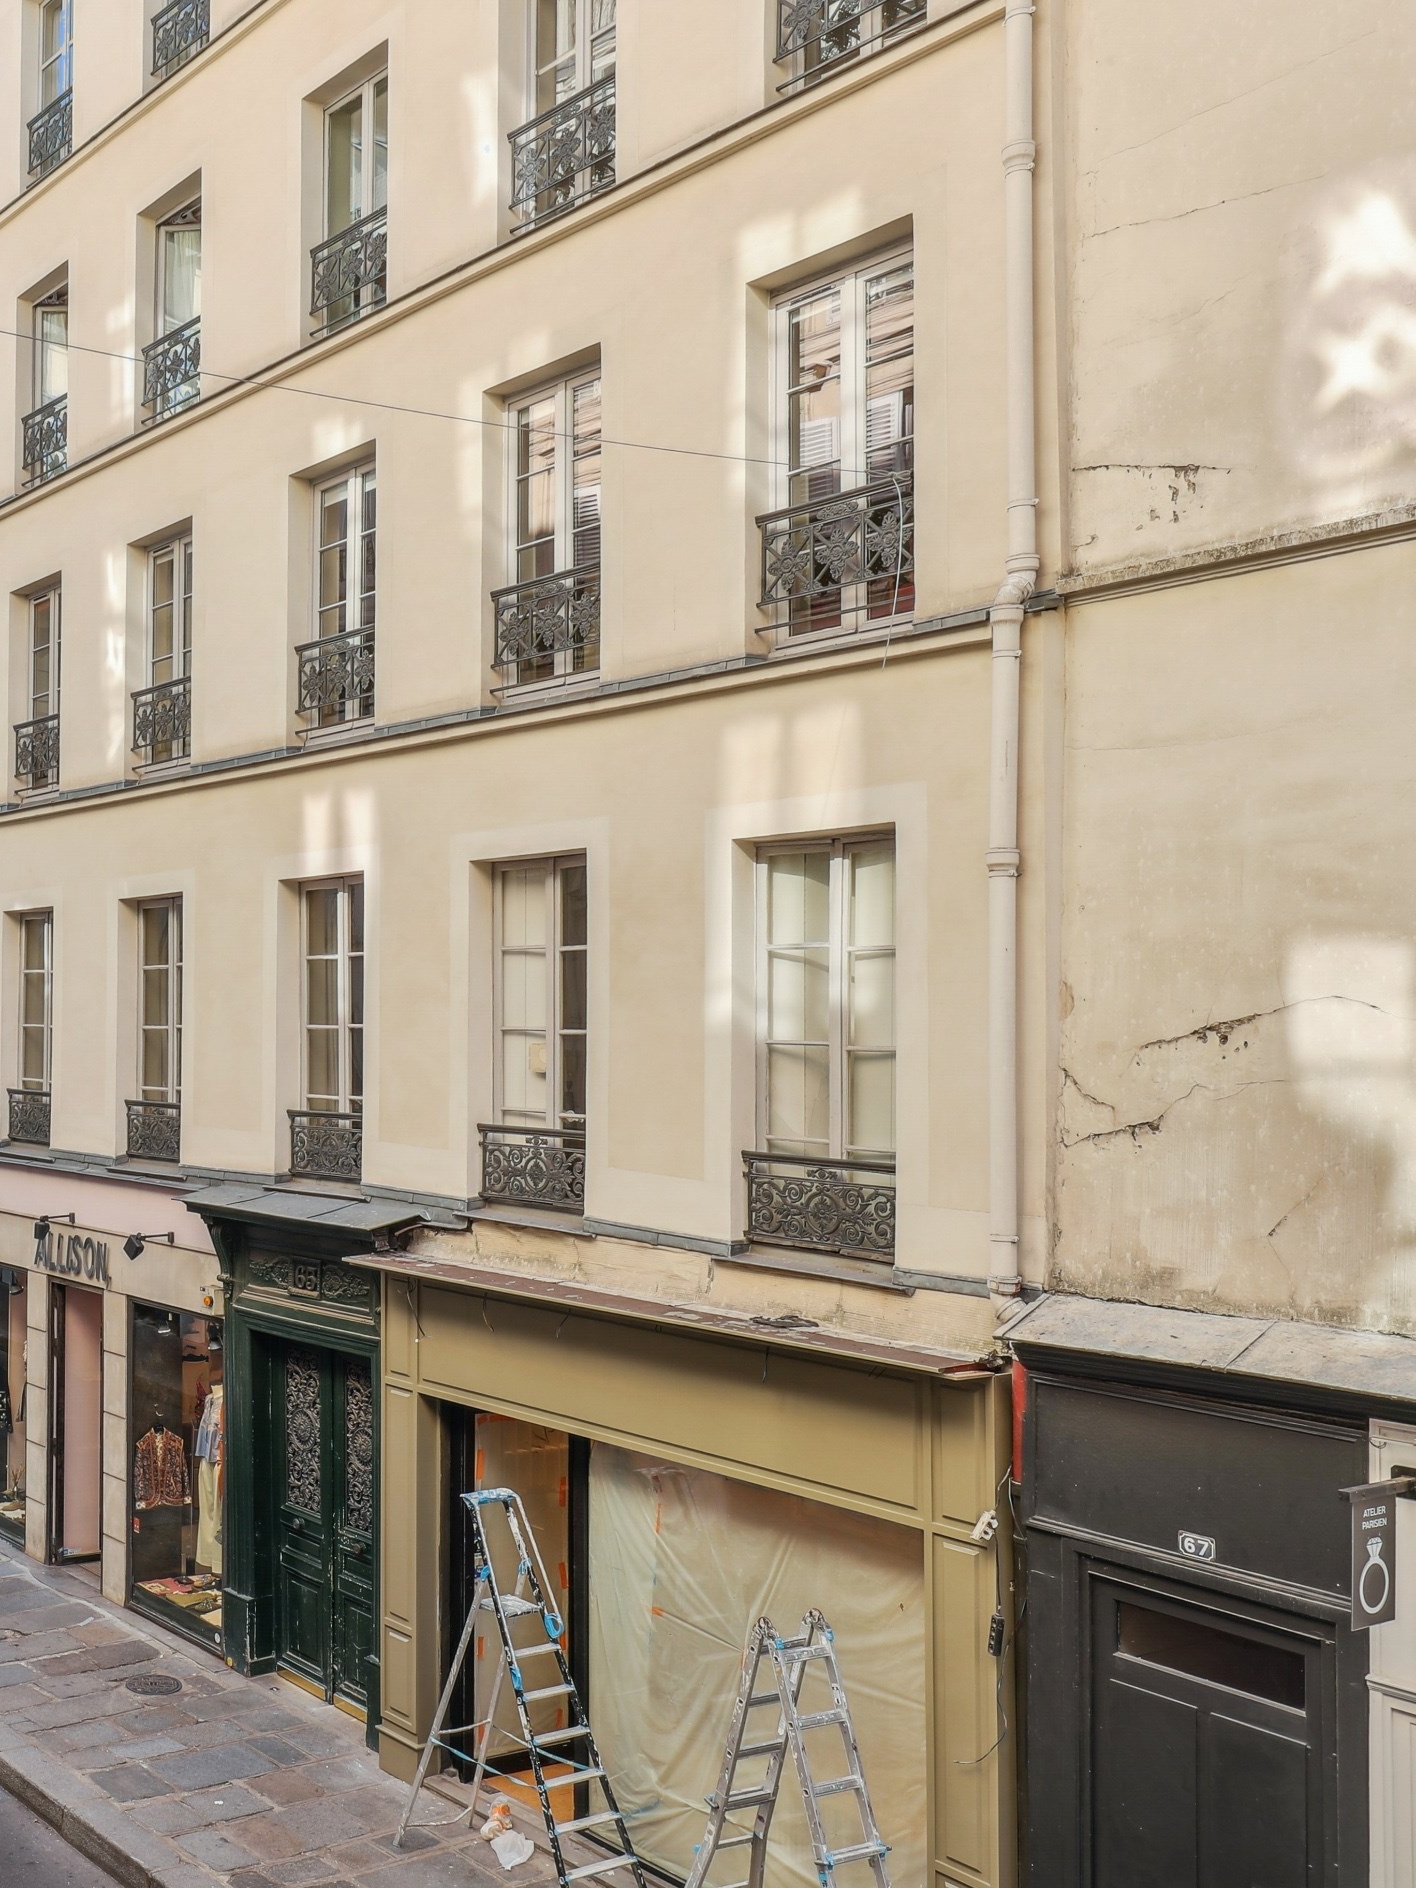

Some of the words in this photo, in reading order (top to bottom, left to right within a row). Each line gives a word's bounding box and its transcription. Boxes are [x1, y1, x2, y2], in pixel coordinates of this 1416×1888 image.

[295, 1265, 316, 1290] 65
[1363, 1505, 1386, 1518] ATELIER
[1361, 1517, 1388, 1530] PARISIEN
[1184, 1537, 1209, 1556] 67
